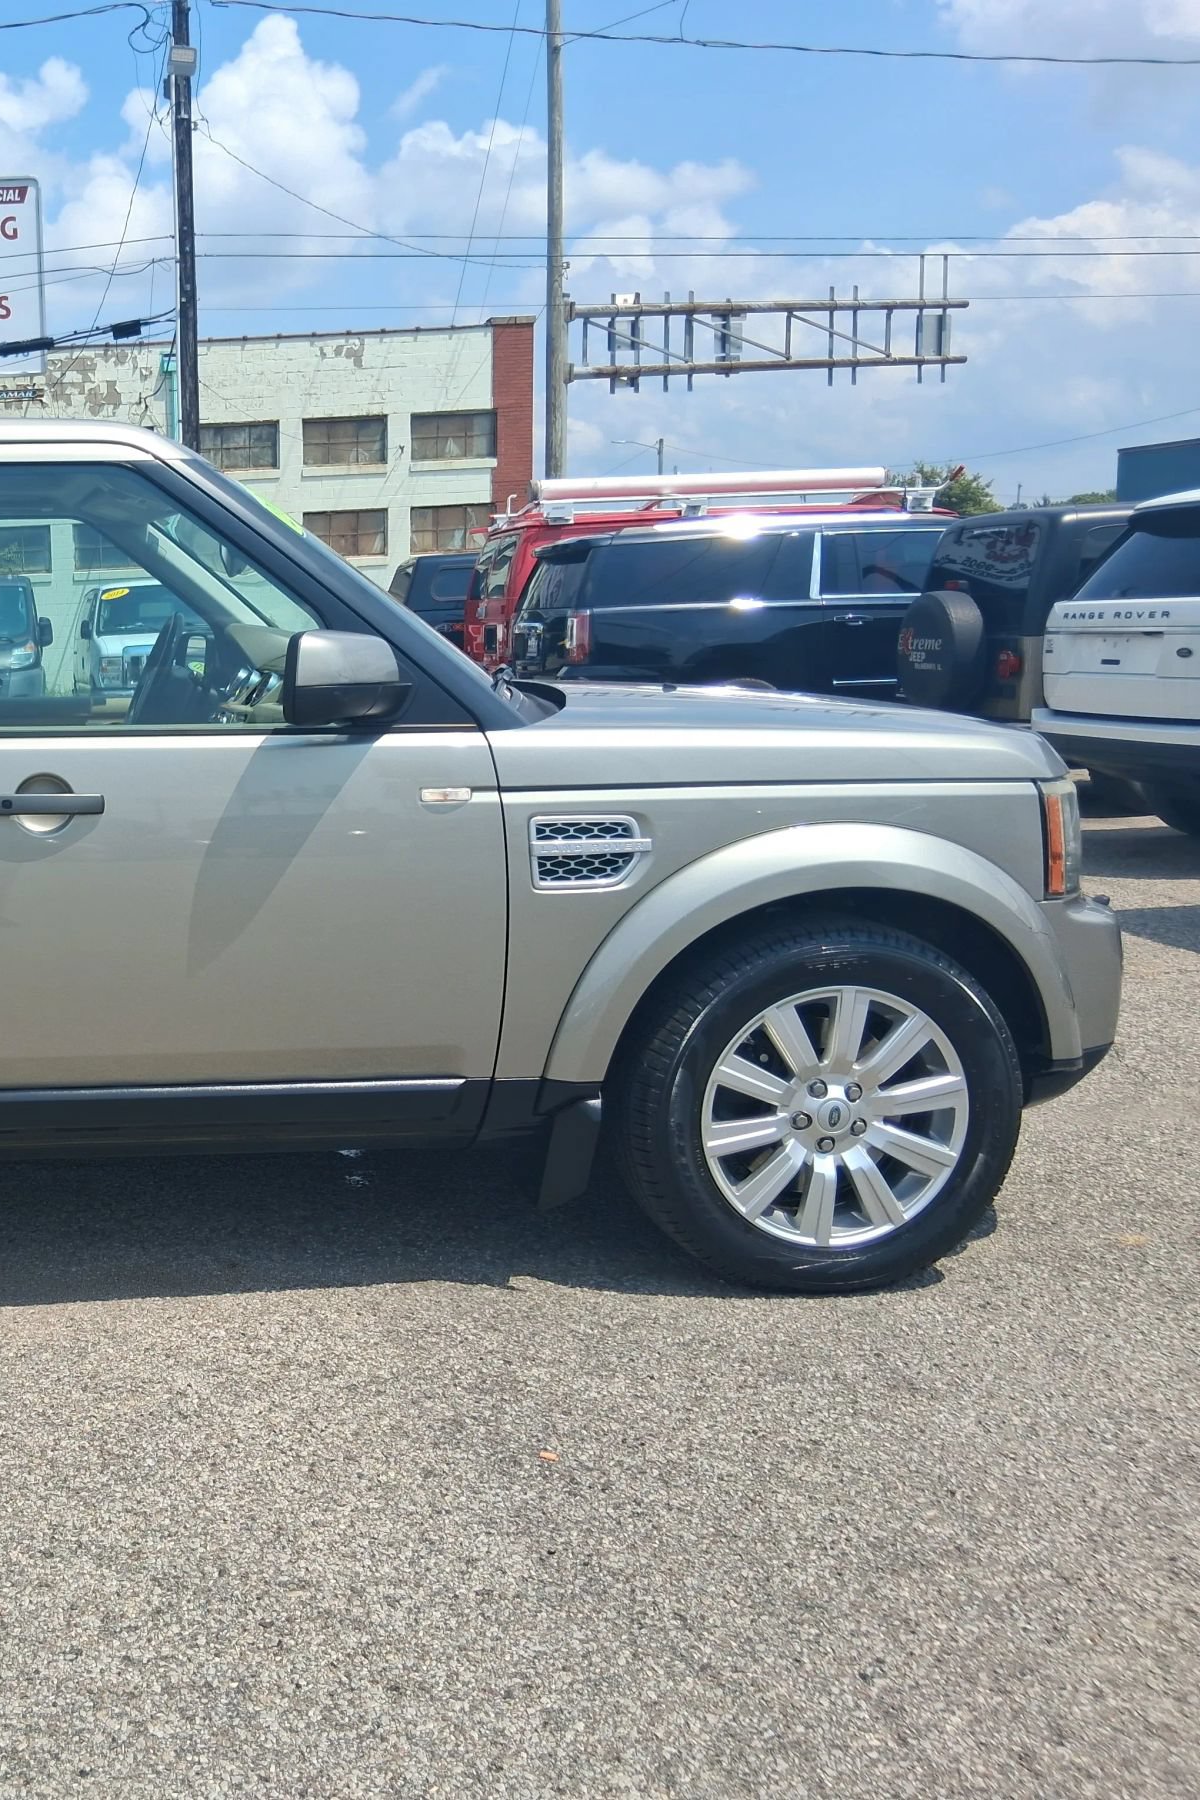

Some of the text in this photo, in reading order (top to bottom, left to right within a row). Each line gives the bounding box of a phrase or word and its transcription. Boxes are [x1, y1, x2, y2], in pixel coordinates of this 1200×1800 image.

[1063, 611, 1171, 620] RANGE ROVER
[909, 651, 926, 662] JEEP
[540, 843, 645, 853] LAND ROVER
